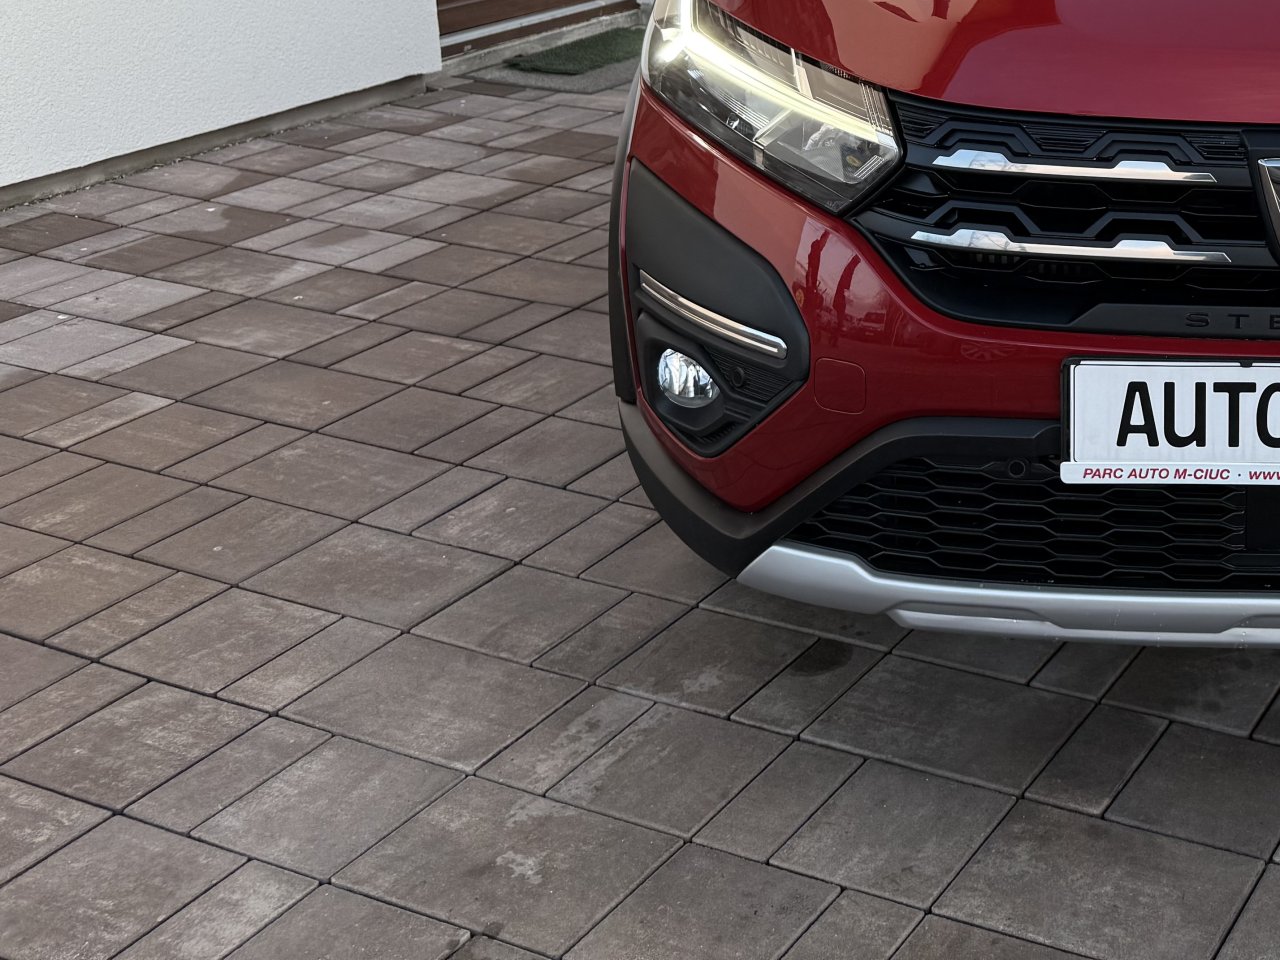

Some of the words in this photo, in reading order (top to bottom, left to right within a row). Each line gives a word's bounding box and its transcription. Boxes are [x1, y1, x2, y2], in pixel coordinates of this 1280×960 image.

[1082, 468, 1124, 479] PARC
[1127, 468, 1170, 480] AUTO
[1173, 468, 1231, 481] M-CIUC
